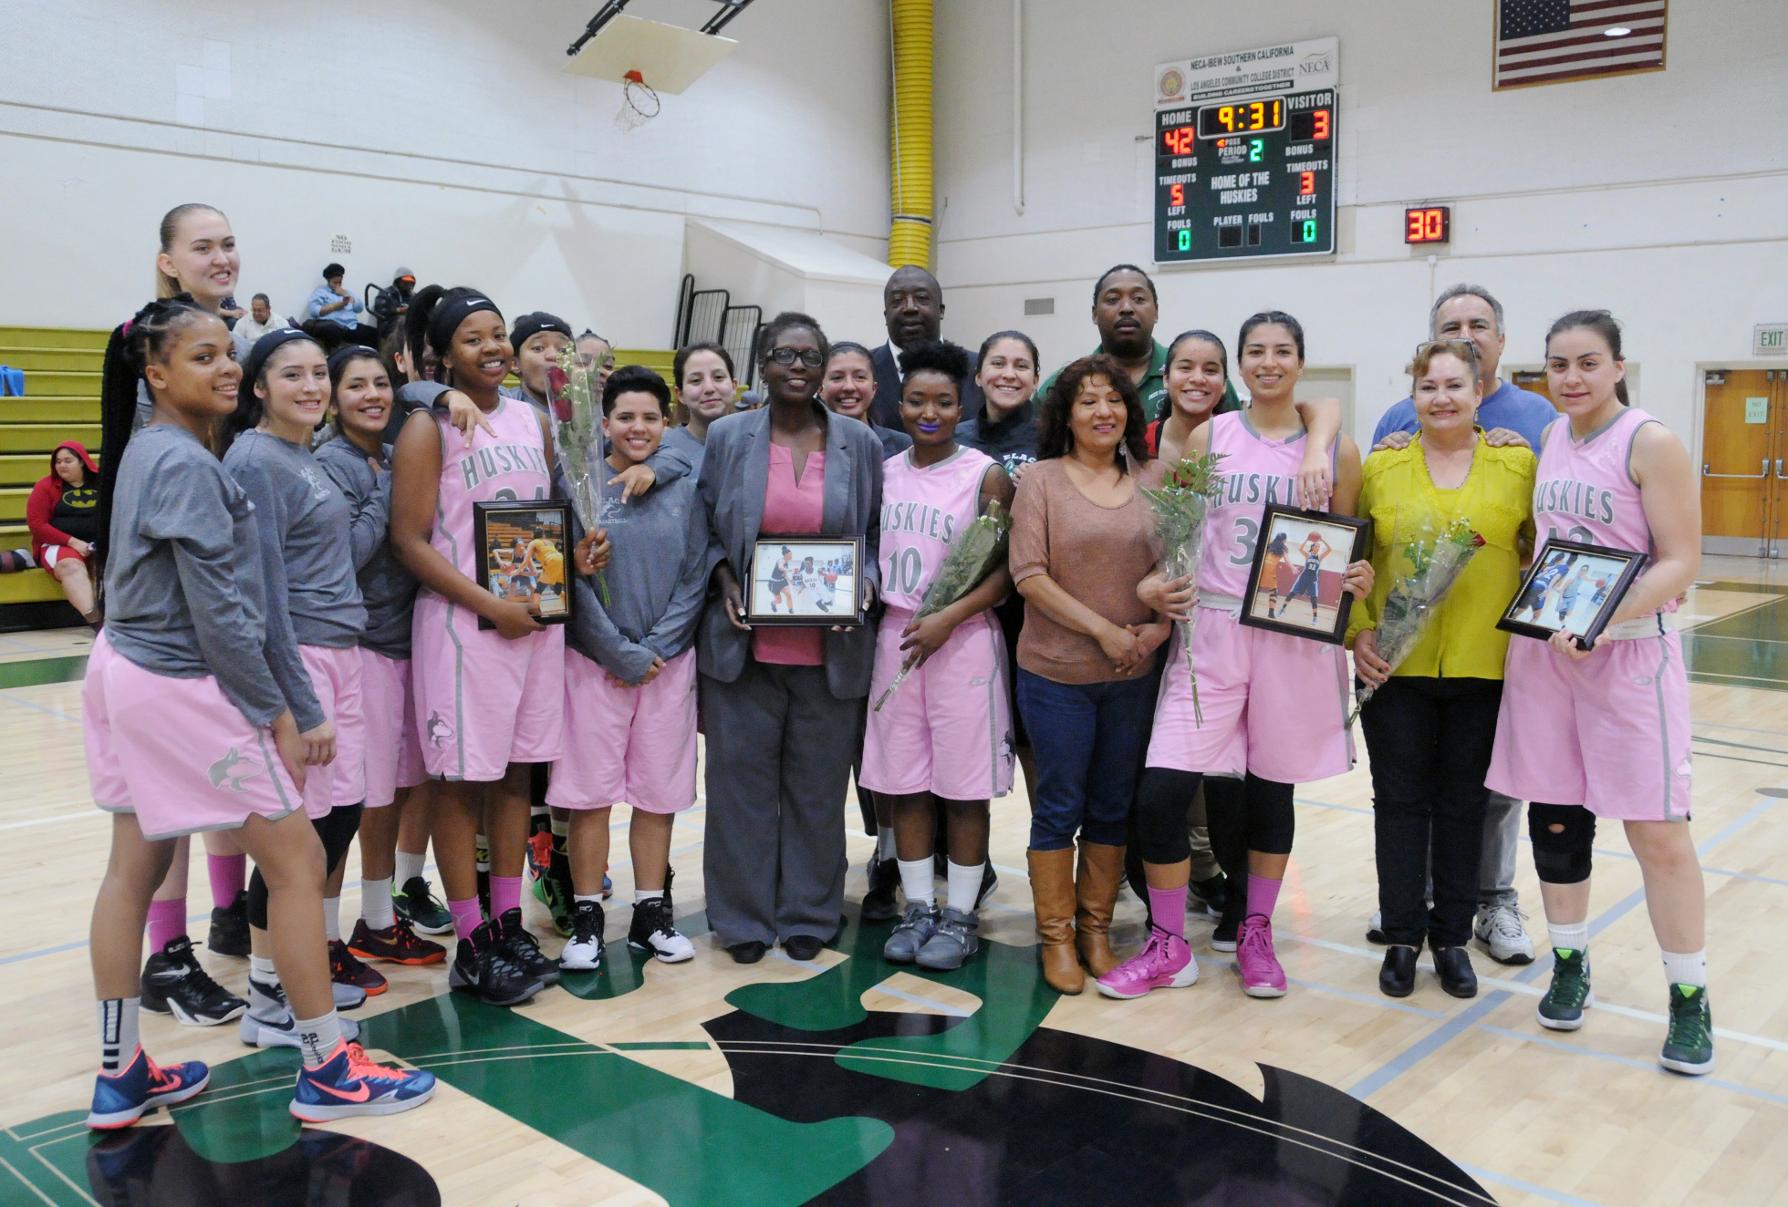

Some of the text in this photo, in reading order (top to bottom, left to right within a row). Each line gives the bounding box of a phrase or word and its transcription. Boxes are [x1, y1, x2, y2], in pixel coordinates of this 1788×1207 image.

[1223, 52, 1256, 66] SOUTHERN
[1257, 45, 1294, 60] CALIFORNIA
[1299, 60, 1330, 73] NECA
[1190, 67, 1294, 91] LOS ANGELES COMMUNITY COLLEGE DISTRICT
[1287, 92, 1332, 110] VISITOR
[1161, 110, 1192, 126] HOME
[1218, 100, 1280, 133] 9:31
[1312, 109, 1330, 140] 3
[1164, 127, 1195, 155] 42
[1218, 145, 1247, 157] PERIOD
[1250, 139, 1264, 162] 2
[1285, 143, 1314, 156] BONUS
[1172, 157, 1198, 168] BONUS
[1286, 159, 1328, 173] TIMEOUTS
[1159, 173, 1197, 186] TIMEOUTS
[1211, 171, 1270, 190] HOME OF THE
[1299, 171, 1315, 195] 3
[1170, 183, 1185, 206] 5
[1220, 188, 1258, 205] HUSKIES
[1296, 194, 1317, 205] LEFT
[1167, 205, 1186, 216] LEFT
[1213, 212, 1274, 226] PLAYER FOULS
[1290, 209, 1317, 220] FOULS
[1167, 218, 1191, 230] FOULS
[1303, 219, 1317, 243] 0
[1408, 209, 1442, 240] 30
[1178, 229, 1191, 252] 0
[1760, 330, 1784, 347] EXIT
[461, 445, 547, 490] HUSKIE
[1536, 479, 1614, 524] USKIES
[881, 502, 954, 545] USKIES
[1230, 518, 1259, 565] 3
[886, 546, 922, 594] 10
